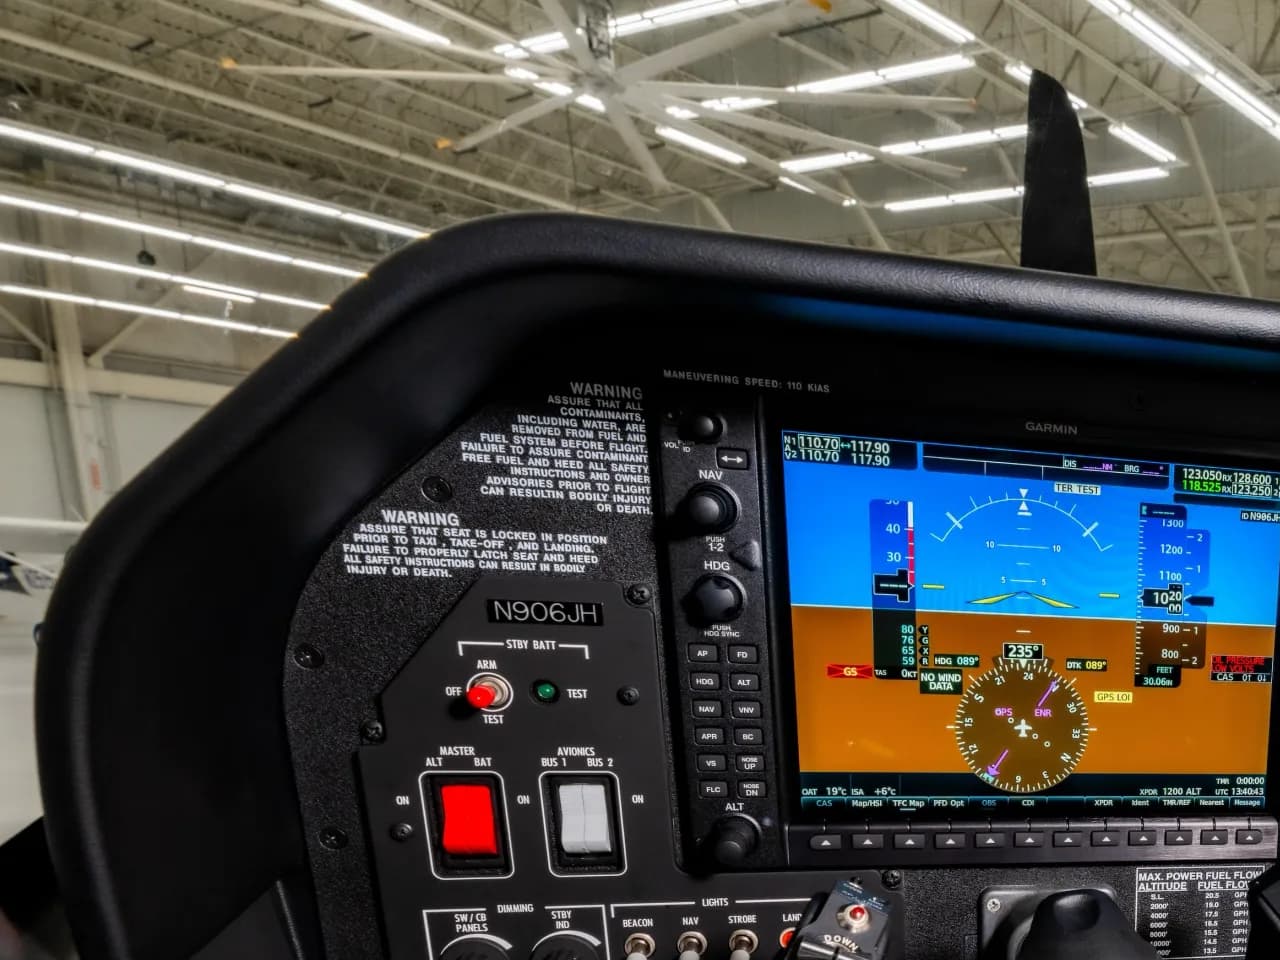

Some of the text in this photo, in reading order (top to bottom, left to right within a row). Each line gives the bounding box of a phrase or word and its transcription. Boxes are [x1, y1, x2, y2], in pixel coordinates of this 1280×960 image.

[663, 369, 830, 393] MANEUVERING SPEED: 110 KIAS
[570, 381, 642, 399] WARNING
[560, 407, 645, 423] CONTAMINANTS,
[518, 415, 646, 432] INCLUDING WATER, ARE
[1025, 422, 1078, 435] GARMIN
[512, 425, 646, 442] REMOVED FROM FUEL AND
[480, 433, 648, 453] FUEL SYSTEM BEFORE FLIGHT.
[800, 437, 890, 453] 110.70 117.90
[461, 442, 648, 463] FAILURE TO ASSURE CONTAMINANT
[800, 450, 890, 466] 110.70 117.90
[1064, 459, 1077, 468] DIS
[1124, 465, 1140, 473] BRG
[699, 470, 723, 480] NAV
[1182, 468, 1222, 481] 123.050
[1055, 484, 1100, 494] TER TEST
[1182, 480, 1221, 492] 118.525
[480, 486, 651, 505] CAN BODILY INJURY
[597, 503, 653, 515] OR DEATH.
[382, 510, 459, 526] WARNING
[360, 524, 607, 544] ASSURE THAT SEAT IS LOCKED IN POSITION
[343, 544, 598, 564] FAILURE TO PROPERLY LATCH SEAT AND HEED
[1160, 544, 1182, 555] 1200
[347, 565, 452, 577] INJURY OR DEATH.
[704, 561, 730, 571] HDG
[1159, 571, 1182, 581] 1100
[493, 601, 598, 623] N906JH
[1162, 623, 1180, 633] 900
[506, 640, 556, 650] STBY BATT
[1008, 645, 1039, 658] 235°
[477, 660, 497, 669] ARM
[935, 656, 979, 665] HDG 089°
[1086, 660, 1107, 670] 089°
[921, 673, 961, 682] NO WIND
[929, 682, 953, 690] DATA
[445, 687, 462, 696] OFF
[567, 689, 588, 698] TEST
[1097, 693, 1114, 701] GPS
[483, 714, 504, 725] TEST
[440, 746, 475, 756] MASTER
[557, 747, 595, 757] AVIONICS
[426, 757, 492, 767] ALT BAT
[541, 758, 558, 766] BUS
[587, 758, 604, 767] BUS
[1236, 776, 1265, 785] 0:00:00
[851, 788, 864, 796] ISA
[1231, 787, 1264, 796] 13:40:43
[396, 795, 409, 805] ON
[517, 795, 530, 804] ON
[631, 794, 644, 804] ON
[816, 799, 832, 807] CAS
[725, 802, 745, 812] ALT
[1138, 872, 1231, 882] MAX. POWER FUEL
[1138, 882, 1188, 891] ALTITUDE
[1205, 891, 1219, 899] 20.5
[702, 897, 729, 908] LIGHTS
[497, 902, 534, 914] DIMMING
[551, 910, 572, 920] STBY
[727, 914, 757, 924] STROBE
[555, 919, 570, 929] IND
[622, 918, 654, 929] BEACON
[682, 916, 699, 927] NAV
[455, 923, 489, 933] PANELS
[824, 934, 859, 953] DOWN
